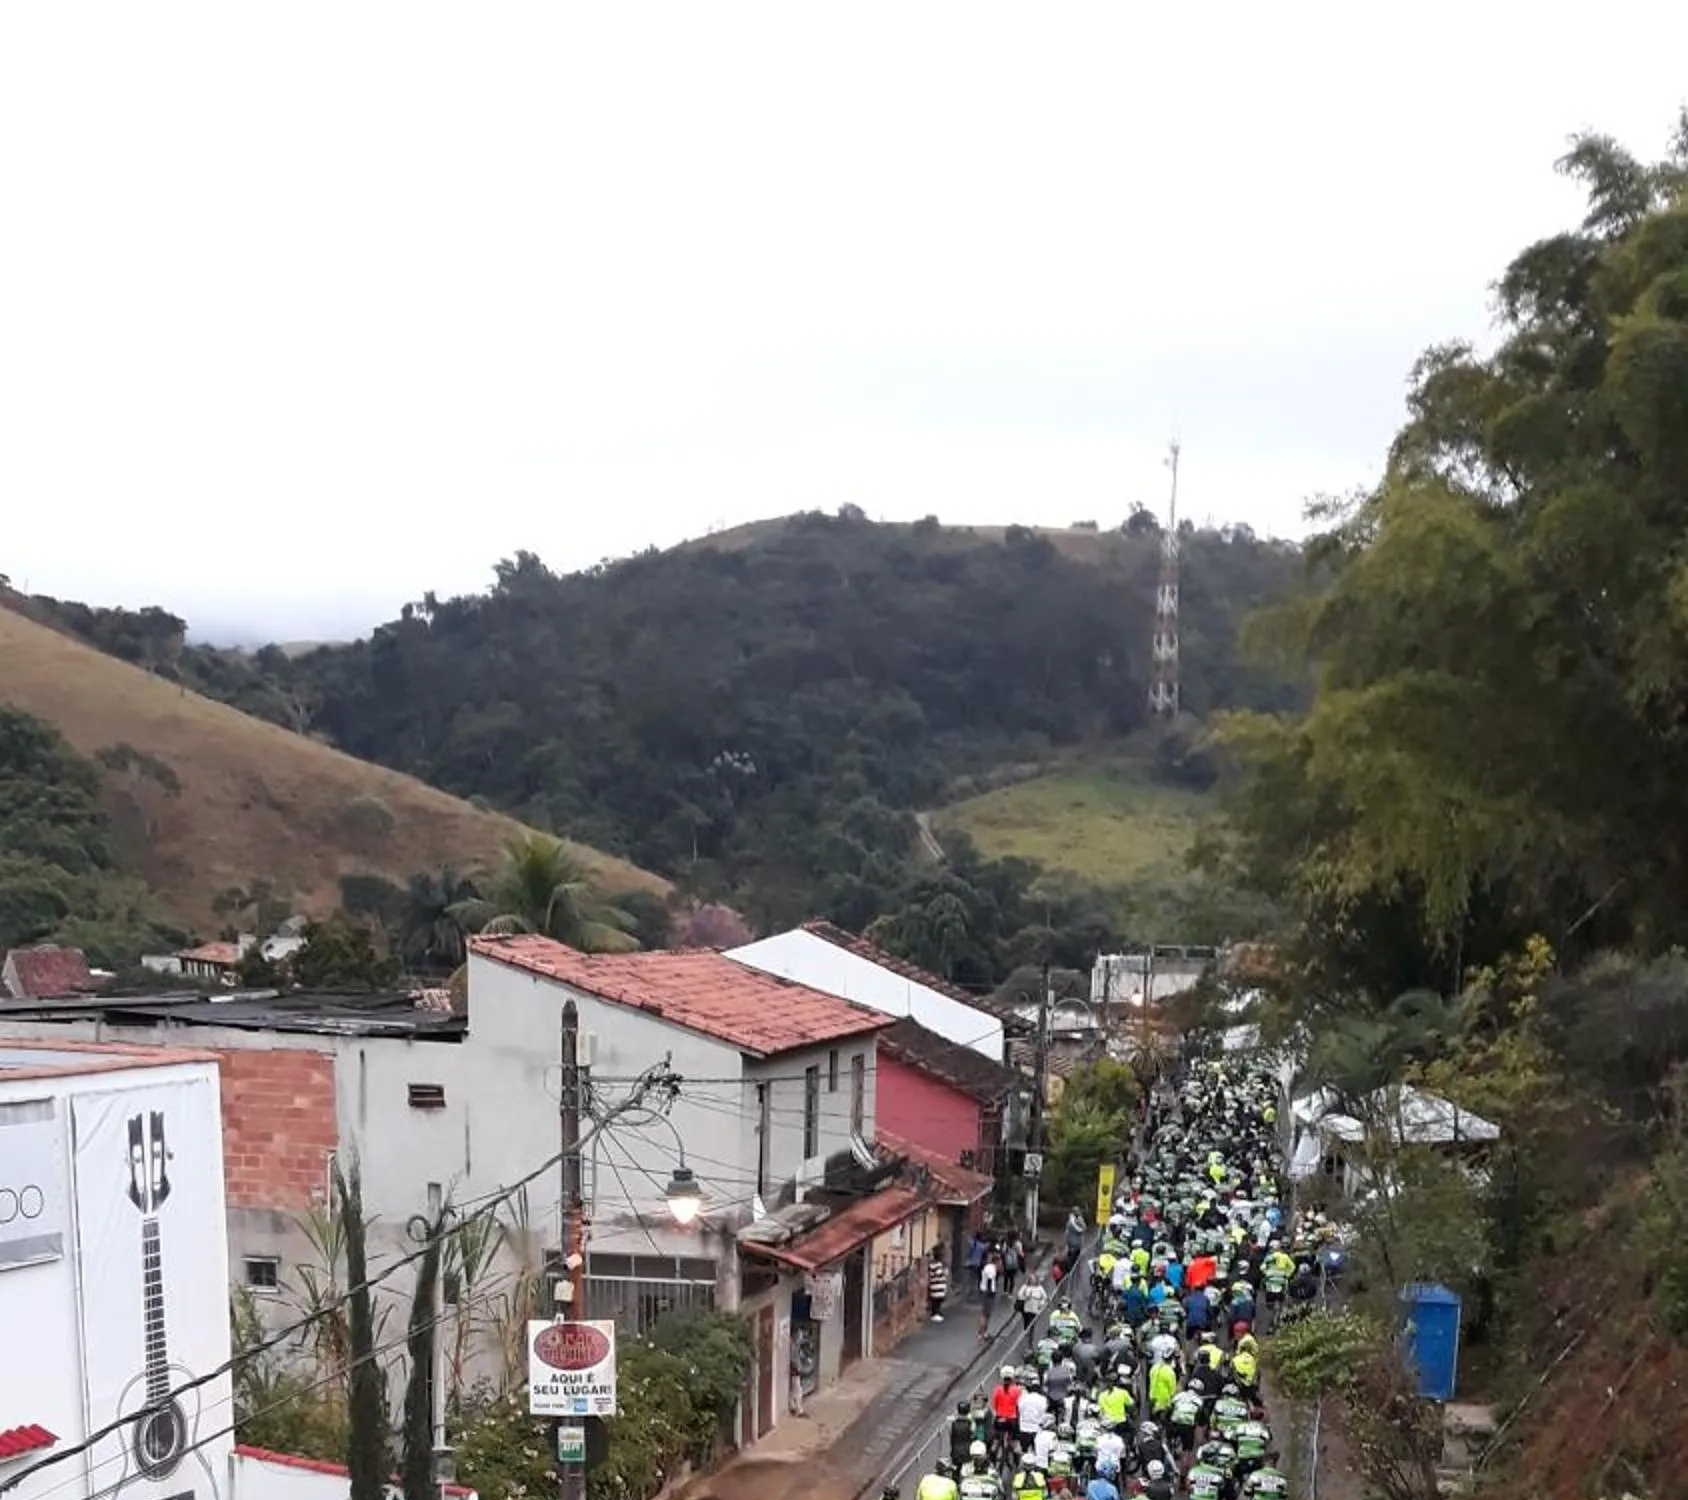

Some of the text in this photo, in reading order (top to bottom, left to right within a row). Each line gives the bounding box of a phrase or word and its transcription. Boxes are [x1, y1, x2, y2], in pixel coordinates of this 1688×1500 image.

[551, 1373, 583, 1384] AQUI
[533, 1385, 613, 1396] SEU LUGAR!
